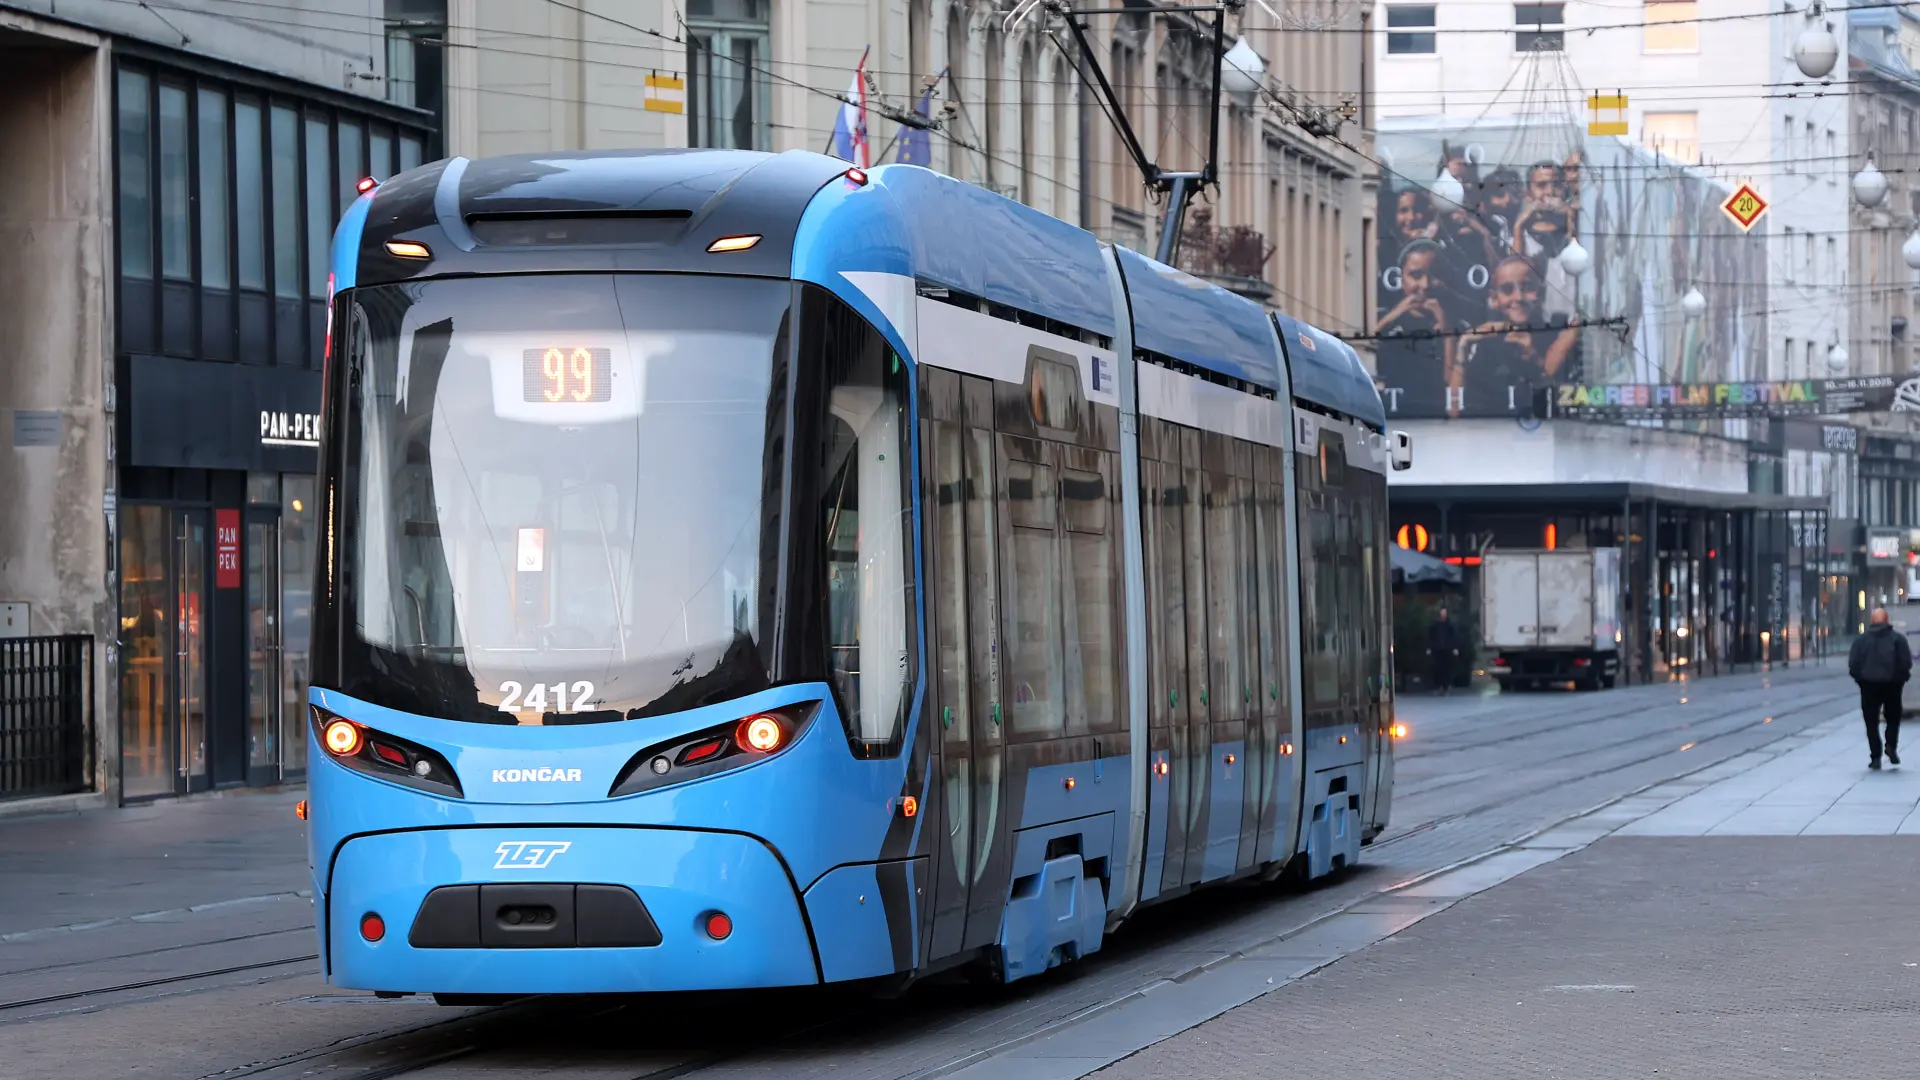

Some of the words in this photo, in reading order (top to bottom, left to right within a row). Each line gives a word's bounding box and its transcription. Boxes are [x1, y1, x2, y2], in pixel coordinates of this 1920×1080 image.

[1740, 197, 1753, 212] 20
[543, 347, 592, 402] 99
[1558, 384, 1649, 406] ZAGREB
[1656, 383, 1709, 405] FILM
[1715, 380, 1819, 405] FESTIVAL
[260, 410, 320, 440] PAN-PEK
[219, 527, 236, 543] PAN
[219, 553, 236, 570] PEK
[498, 680, 595, 712] 2412
[493, 841, 572, 869] ZET
